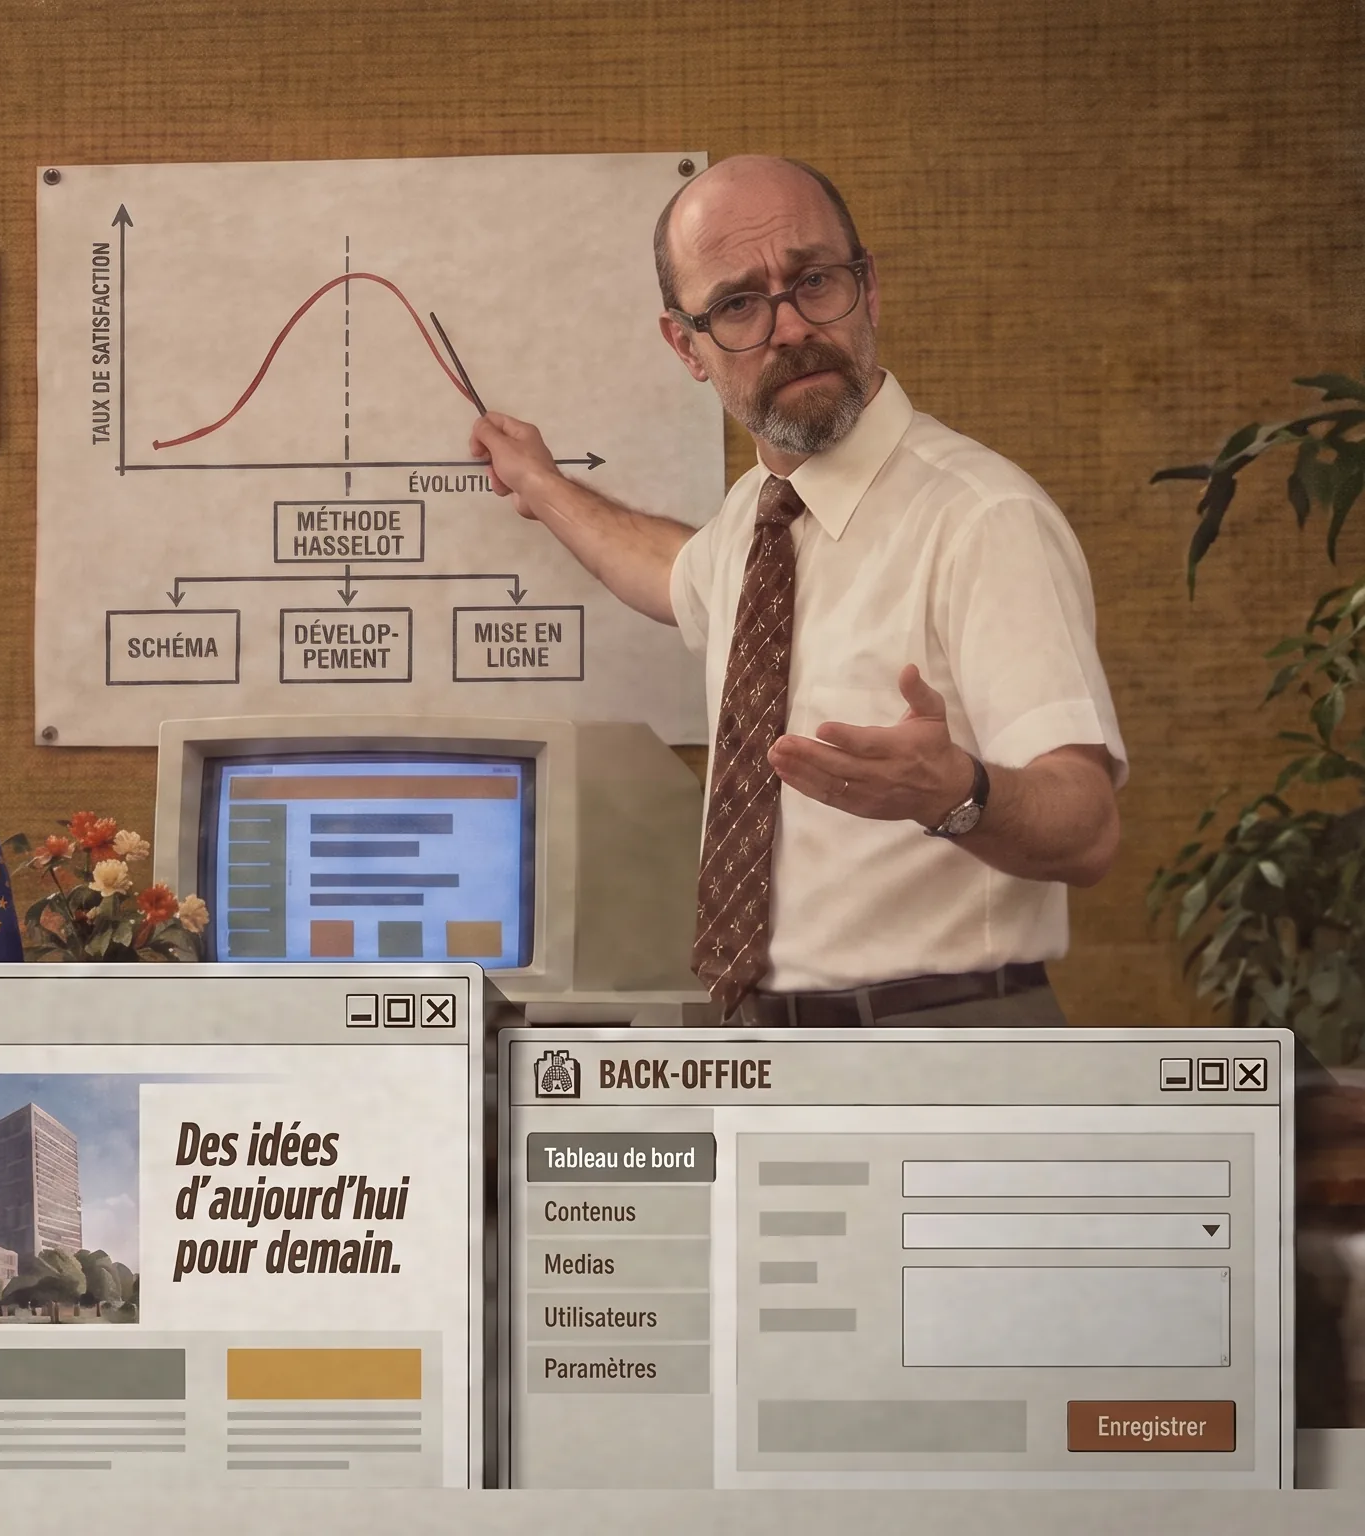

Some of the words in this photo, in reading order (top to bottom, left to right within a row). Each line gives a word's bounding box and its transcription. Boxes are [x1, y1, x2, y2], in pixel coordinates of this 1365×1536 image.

[92, 242, 110, 365] SATISFACTION
[92, 371, 110, 394] DE
[92, 400, 110, 445] TAUX
[297, 508, 401, 533] MÉTHODE
[293, 535, 404, 557] HASSELOT
[127, 630, 218, 659] SCHÉMA
[293, 619, 399, 646] DÉVELOP-
[473, 621, 528, 644] MISE
[535, 621, 562, 643] EN
[303, 648, 391, 670] PEMENT
[485, 646, 550, 669] LIGNE
